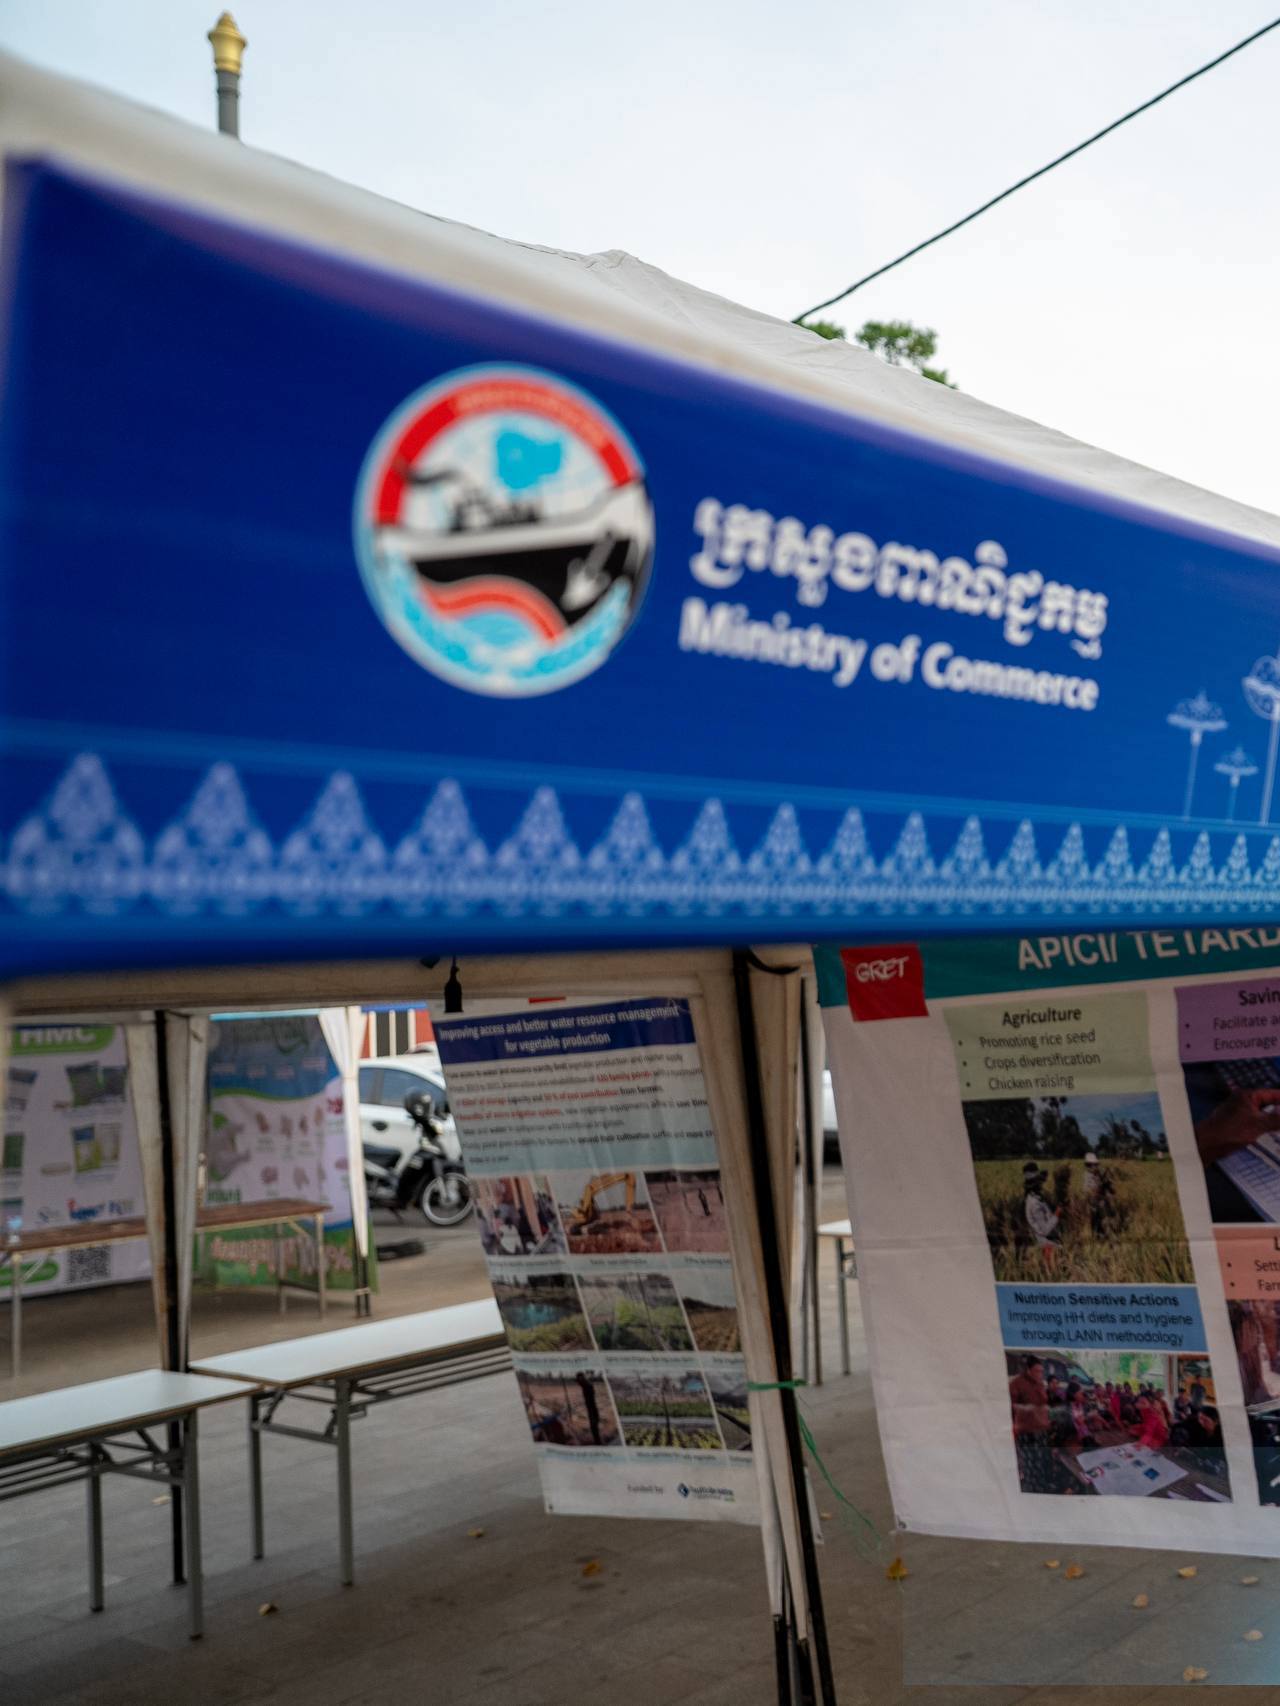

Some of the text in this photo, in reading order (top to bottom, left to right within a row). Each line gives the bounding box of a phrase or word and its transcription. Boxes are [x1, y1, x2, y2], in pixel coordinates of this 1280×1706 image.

[678, 597, 1100, 711] Ministry of Commerce
[855, 956, 910, 983] GRET
[506, 1020, 522, 1033] and
[577, 1013, 616, 1027] resource
[617, 1005, 680, 1022] management
[1002, 1006, 1082, 1027] Agriculture
[1213, 1013, 1268, 1030] Facilitate
[519, 1035, 560, 1053] vegetable
[562, 1031, 612, 1050] production
[979, 1028, 1096, 1050] Promoting rice seed
[1213, 1034, 1277, 1051] Encourage
[984, 1052, 1101, 1071] Crops diversification
[988, 1073, 1075, 1090] Chicken raising
[1014, 1291, 1180, 1307] Nutrition Sensitive Actions
[1008, 1310, 1193, 1328] Improving HH diets and hygiene
[1022, 1329, 1184, 1347] through LANN methodology
